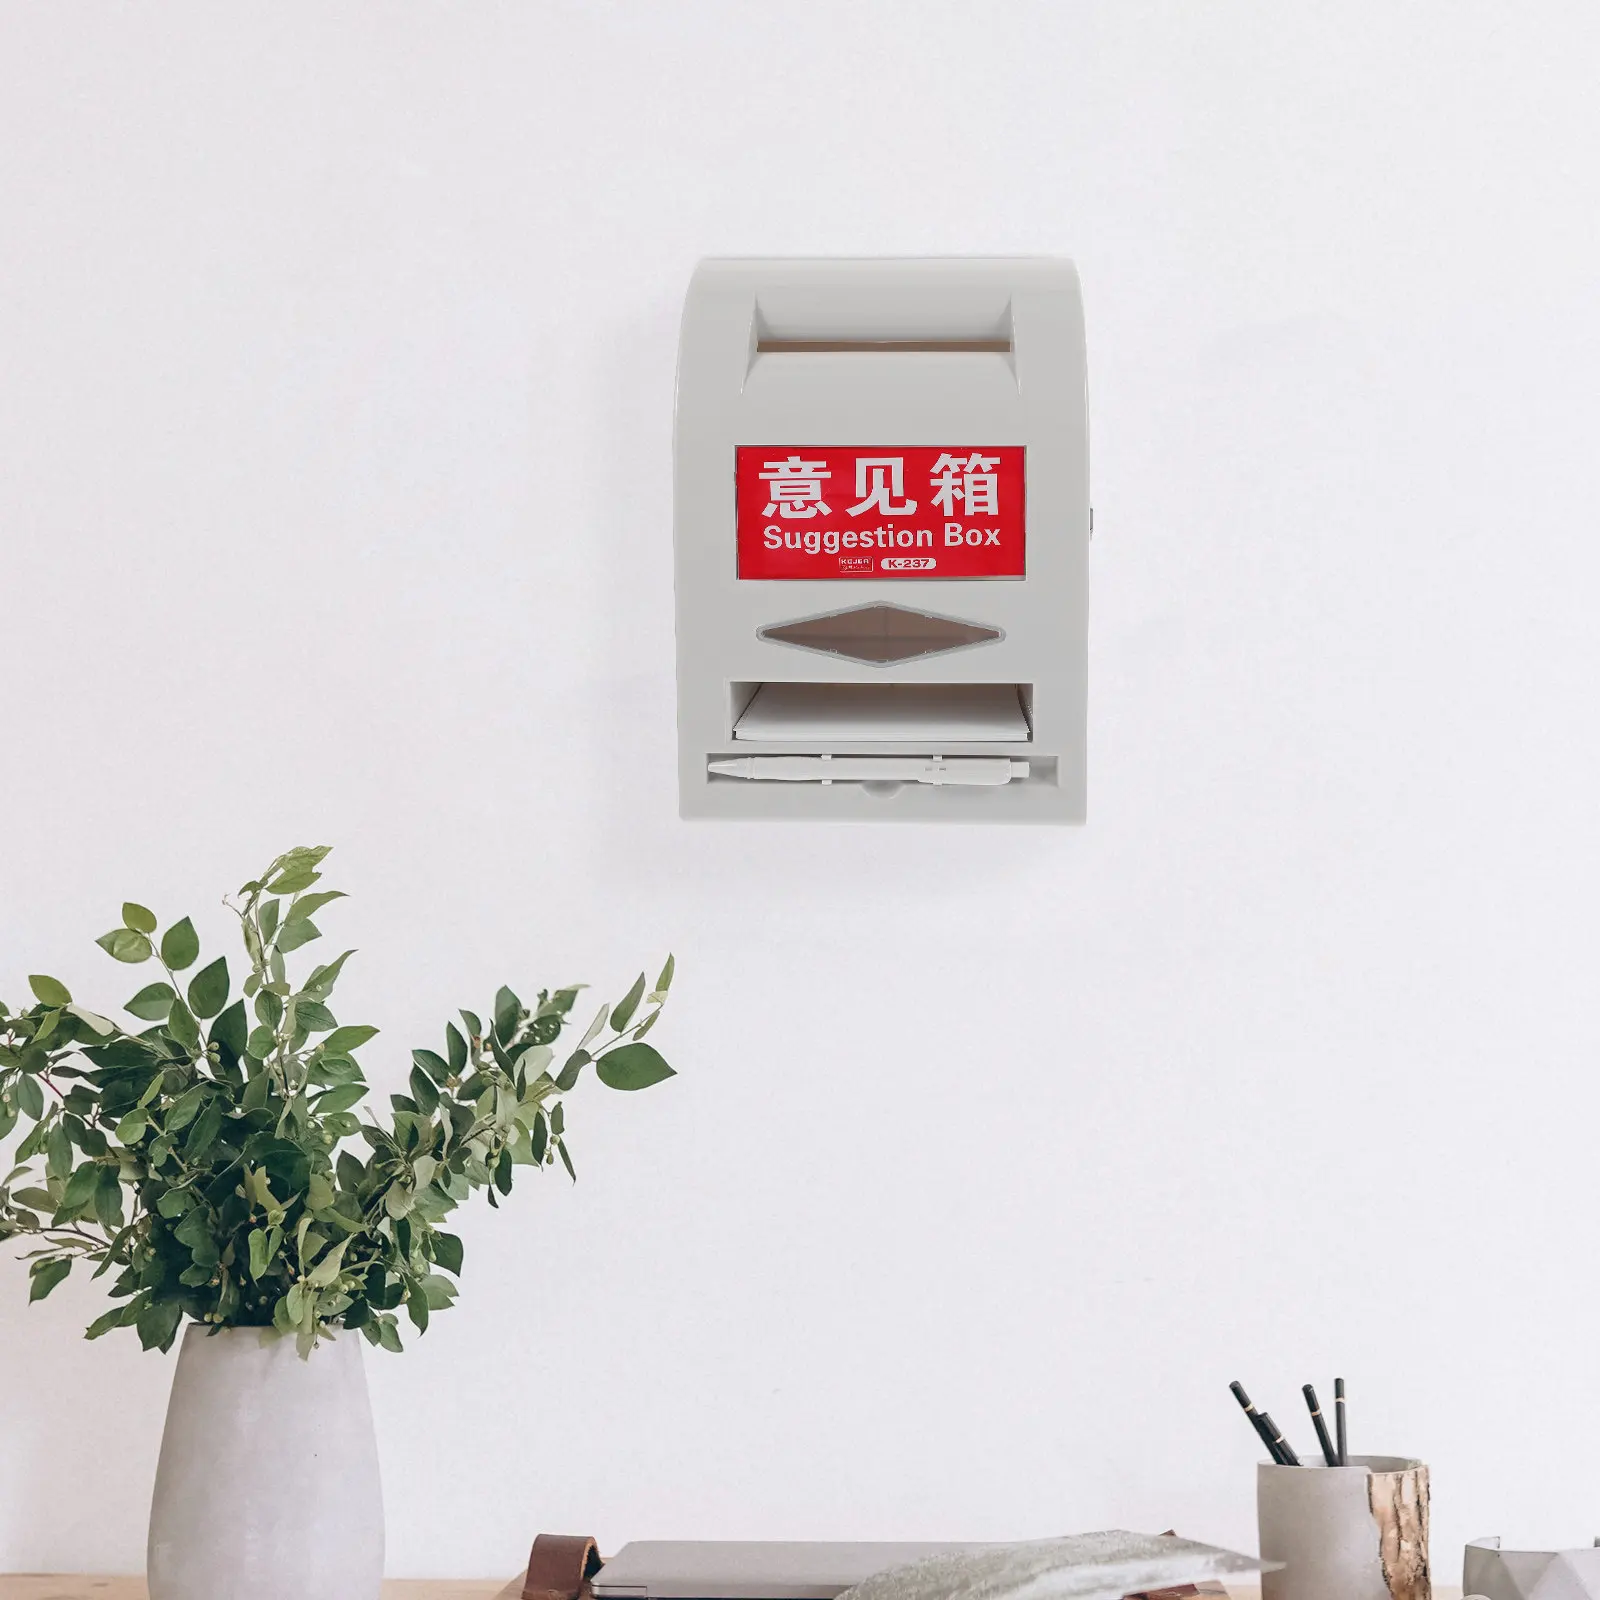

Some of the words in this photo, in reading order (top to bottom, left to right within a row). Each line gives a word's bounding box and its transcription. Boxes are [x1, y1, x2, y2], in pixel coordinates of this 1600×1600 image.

[758, 452, 1001, 519] 意见箱
[763, 523, 934, 555] Suggestion
[944, 522, 1001, 547] Box
[887, 558, 930, 569] K-237
